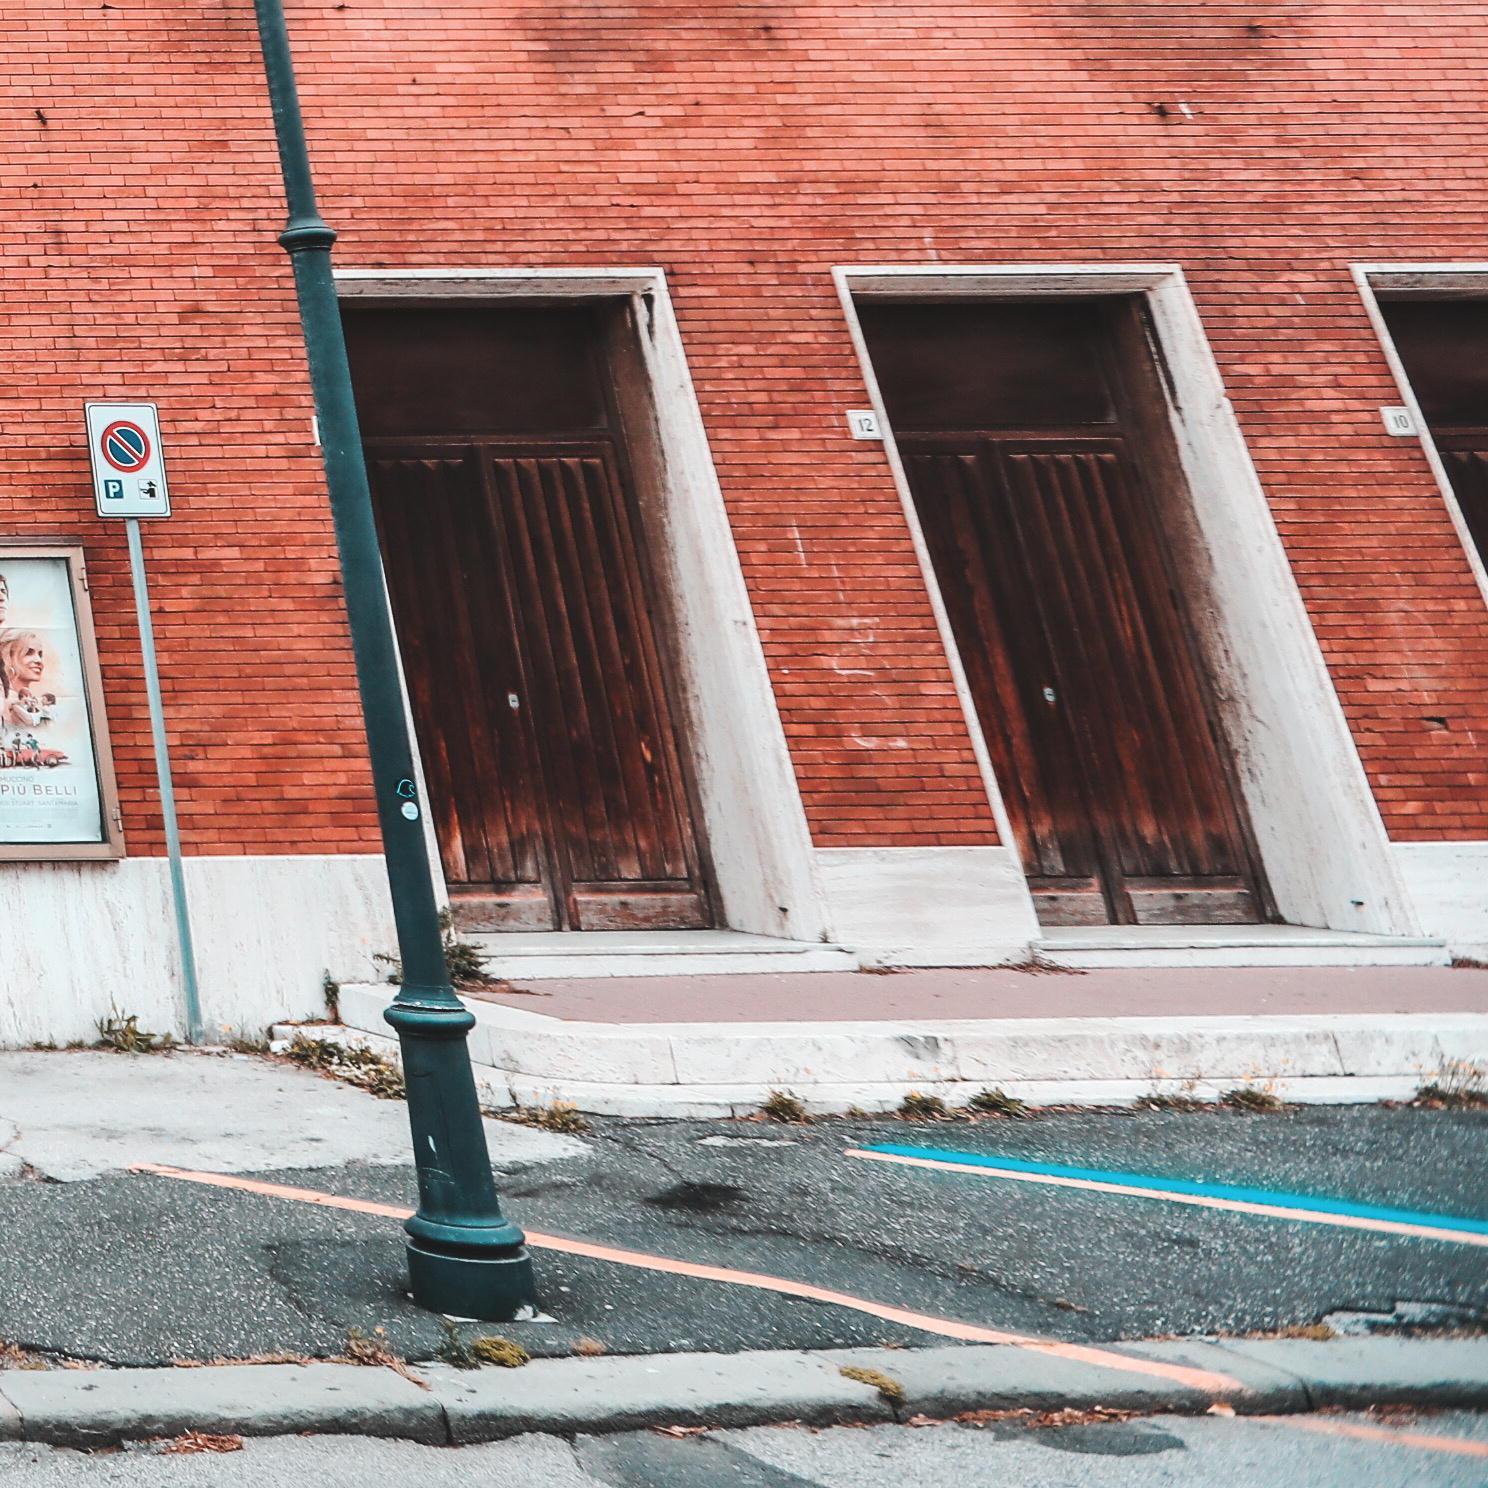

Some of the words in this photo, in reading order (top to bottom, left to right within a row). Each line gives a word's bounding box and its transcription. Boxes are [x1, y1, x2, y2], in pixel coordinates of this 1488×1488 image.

[858, 418, 874, 432] 12
[1394, 414, 1410, 429] 10
[107, 481, 121, 498] P
[1, 783, 27, 796] PIÙ
[33, 784, 77, 796] BELLI
